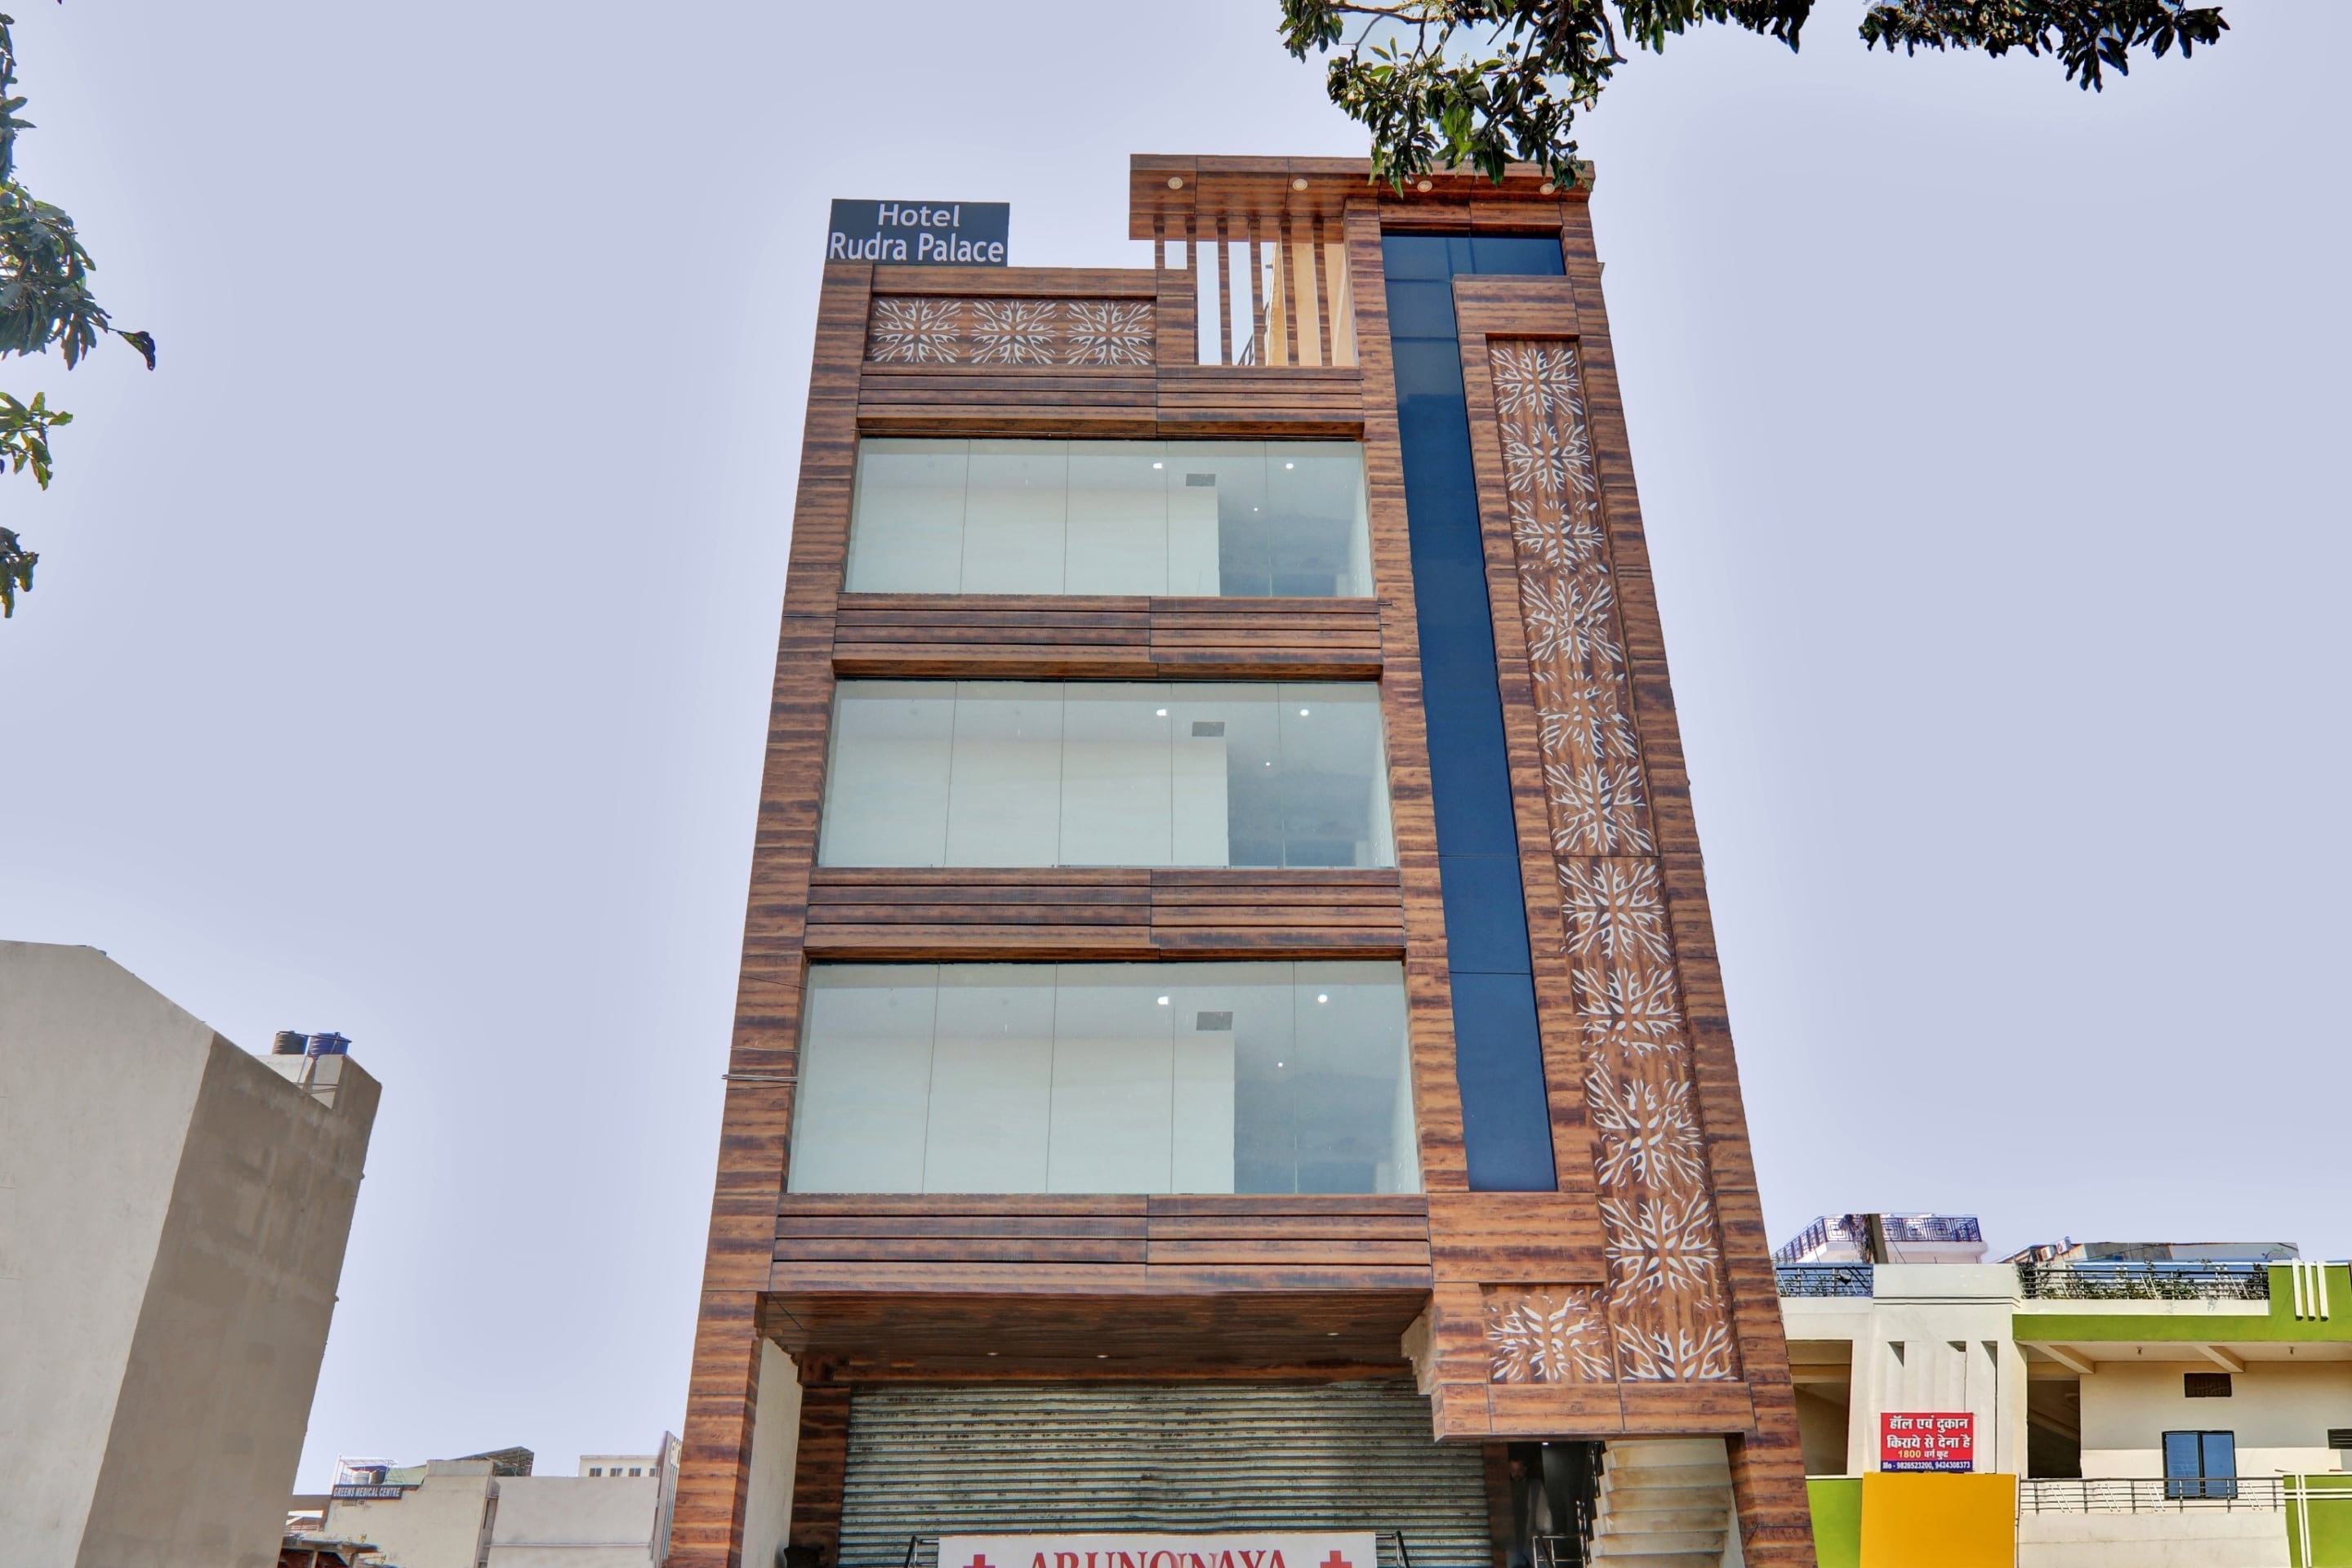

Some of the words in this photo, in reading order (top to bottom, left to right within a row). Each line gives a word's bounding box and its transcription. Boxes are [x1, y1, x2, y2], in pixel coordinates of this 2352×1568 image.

[878, 203, 960, 227] Hotel
[829, 231, 907, 261] Rudra
[918, 233, 1004, 262] Palace
[1890, 1415, 1913, 1429] हॉल
[1916, 1415, 1935, 1429] एवं
[1936, 1419, 1968, 1432] दुकान
[1886, 1434, 1922, 1449] किराये
[1924, 1434, 1935, 1449] से
[1937, 1434, 1959, 1448] देना
[1898, 1450, 1922, 1459] 1800
[354, 1487, 378, 1497] MEDICAL
[379, 1487, 400, 1497] CENTRE
